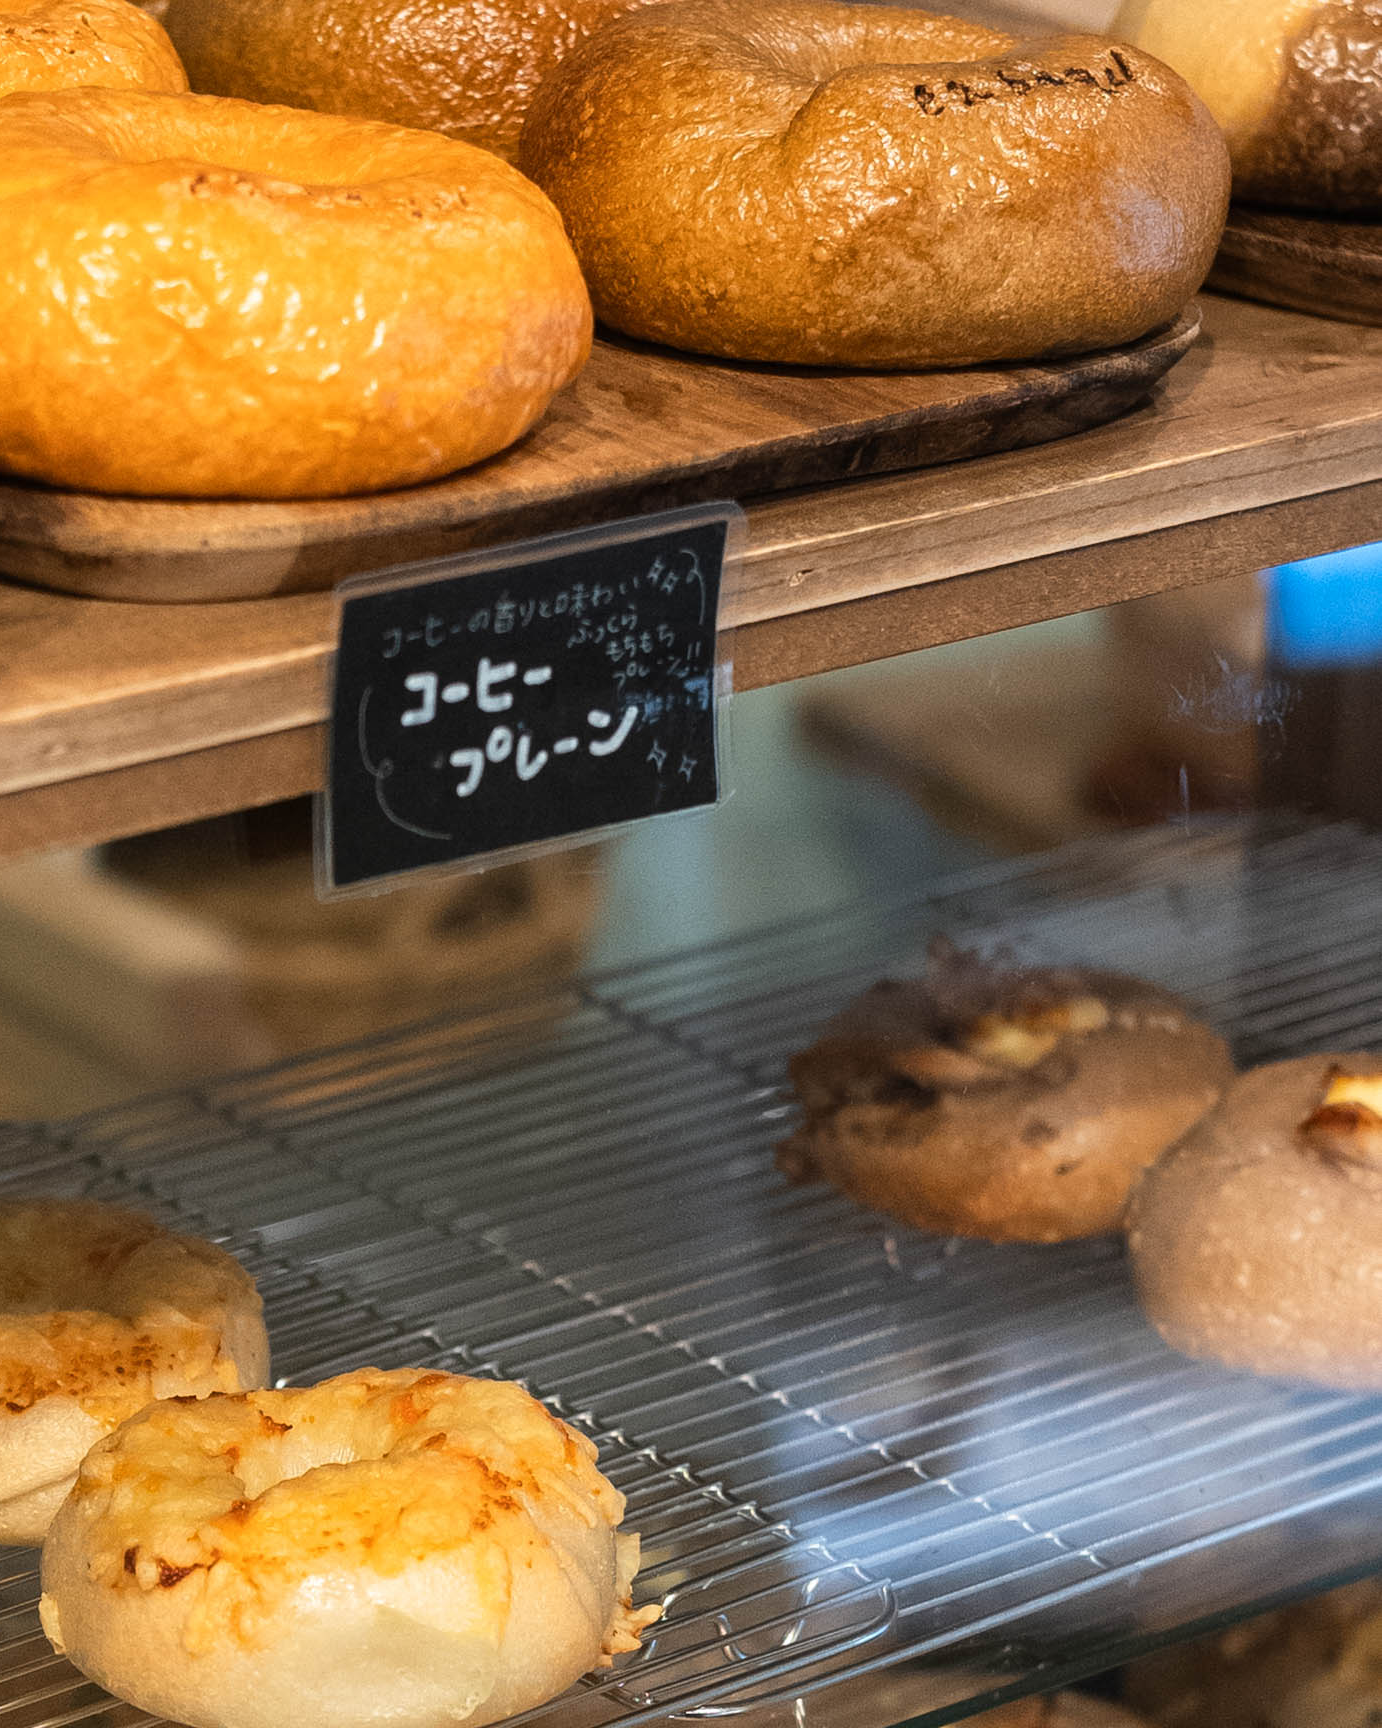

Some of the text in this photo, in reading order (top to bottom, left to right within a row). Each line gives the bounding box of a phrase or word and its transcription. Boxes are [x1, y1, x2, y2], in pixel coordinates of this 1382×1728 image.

[605, 624, 676, 662] もちもち
[400, 656, 553, 728] コーヒー
[448, 704, 640, 798] プレーン
